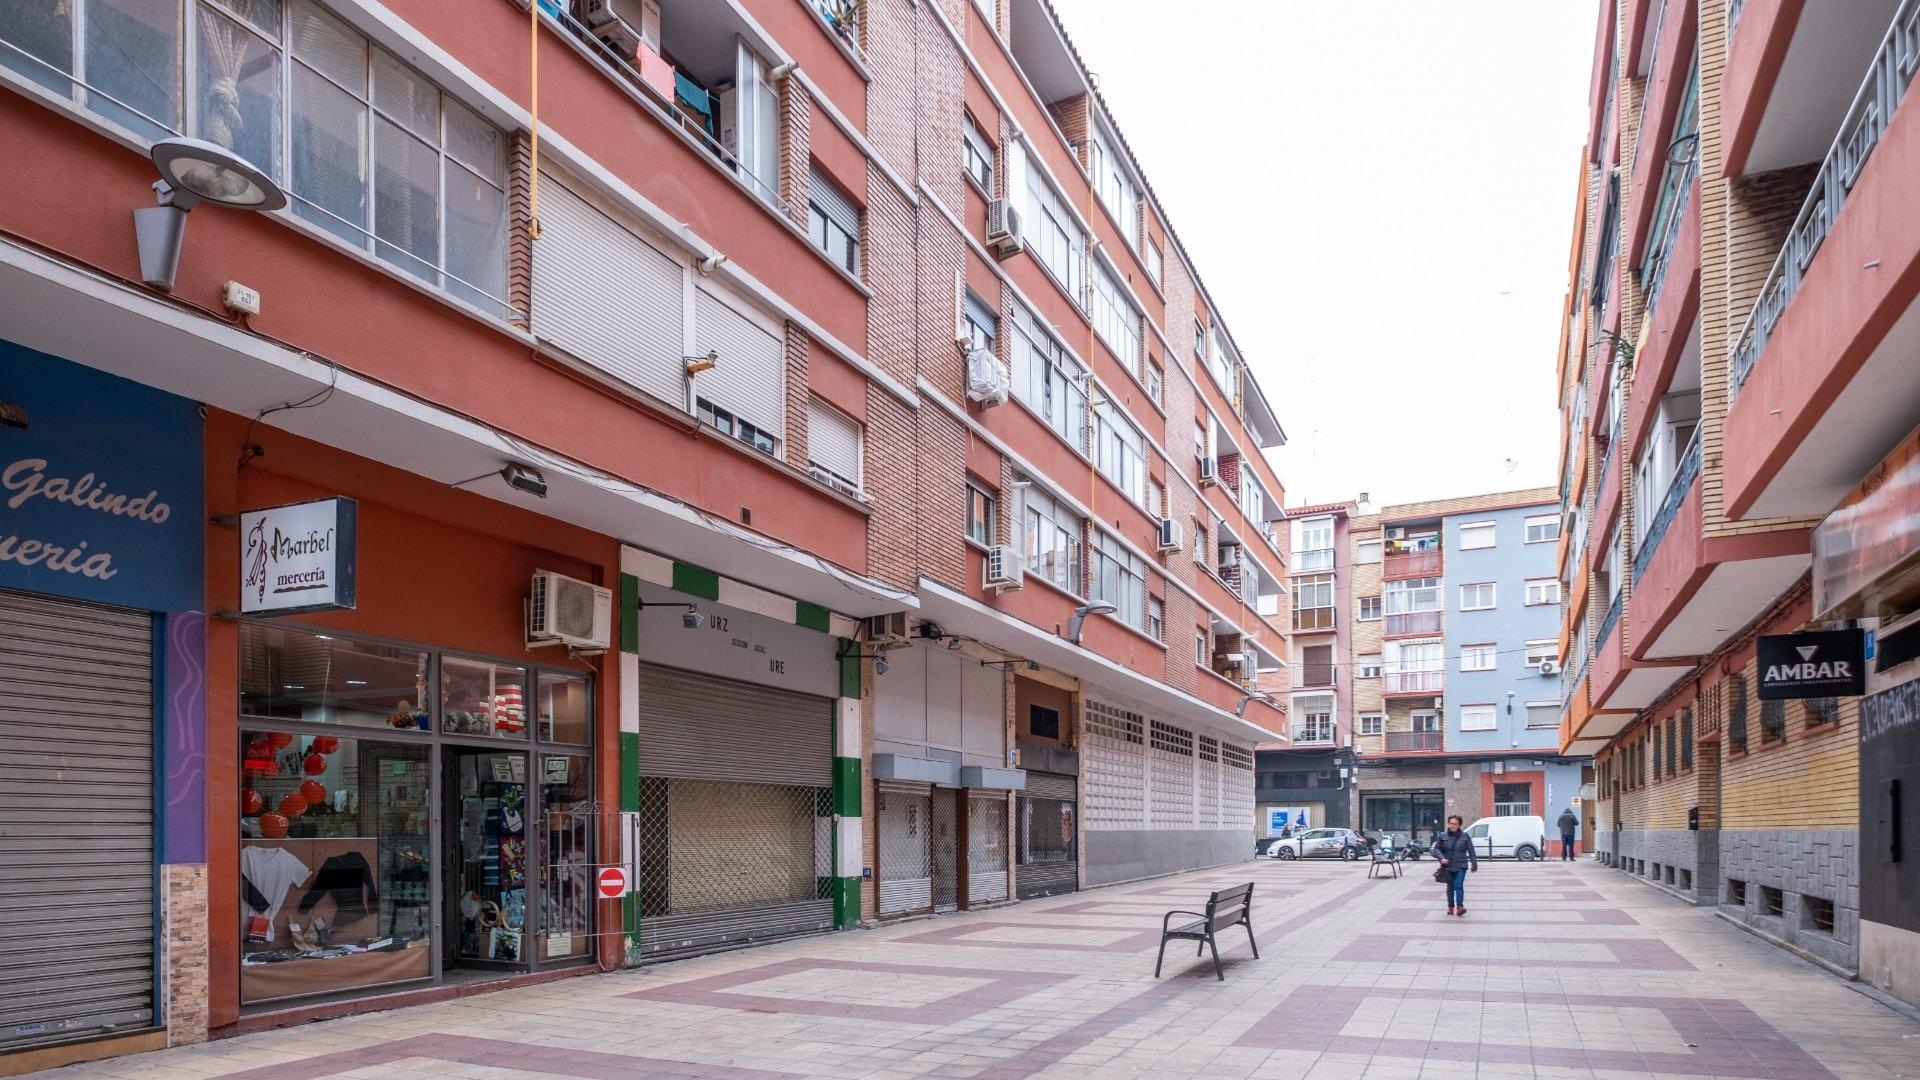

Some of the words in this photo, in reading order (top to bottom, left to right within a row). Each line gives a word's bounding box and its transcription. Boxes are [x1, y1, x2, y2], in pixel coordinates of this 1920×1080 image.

[2, 458, 171, 524] Galindo
[277, 567, 325, 586] mercería
[710, 614, 729, 632] URZ
[769, 658, 785, 675] URE
[1764, 661, 1853, 682] AMBAR
